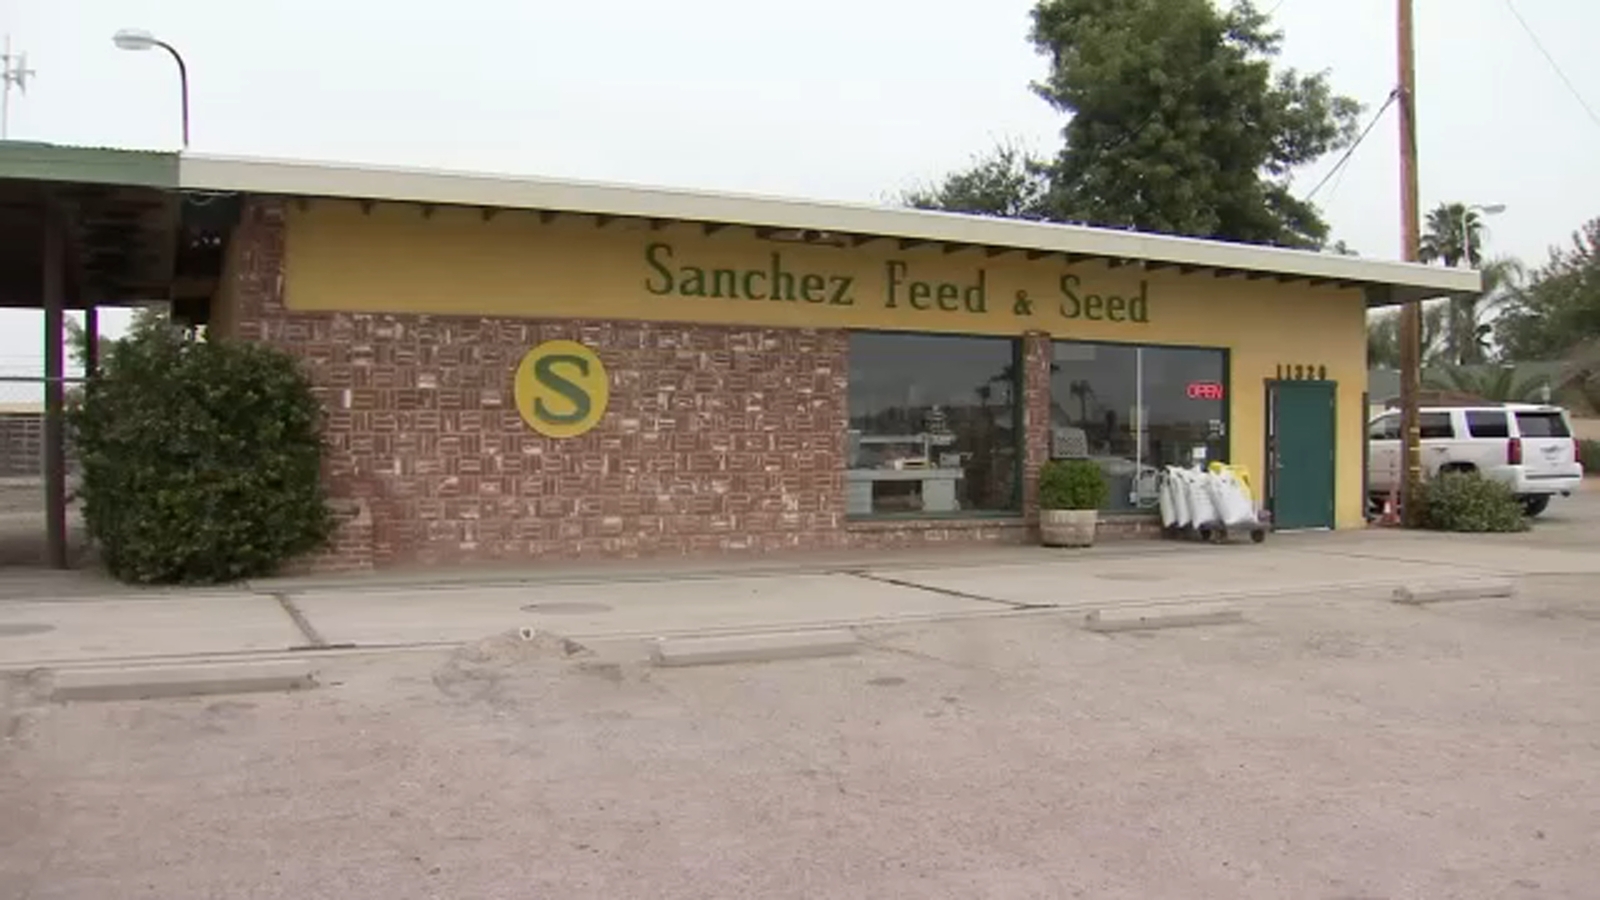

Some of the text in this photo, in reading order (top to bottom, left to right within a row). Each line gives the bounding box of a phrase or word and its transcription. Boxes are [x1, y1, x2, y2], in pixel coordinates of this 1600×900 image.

[645, 243, 1149, 323] Sanchez Feed & Seed
[534, 355, 590, 424] S
[1186, 383, 1223, 399] OPEN
